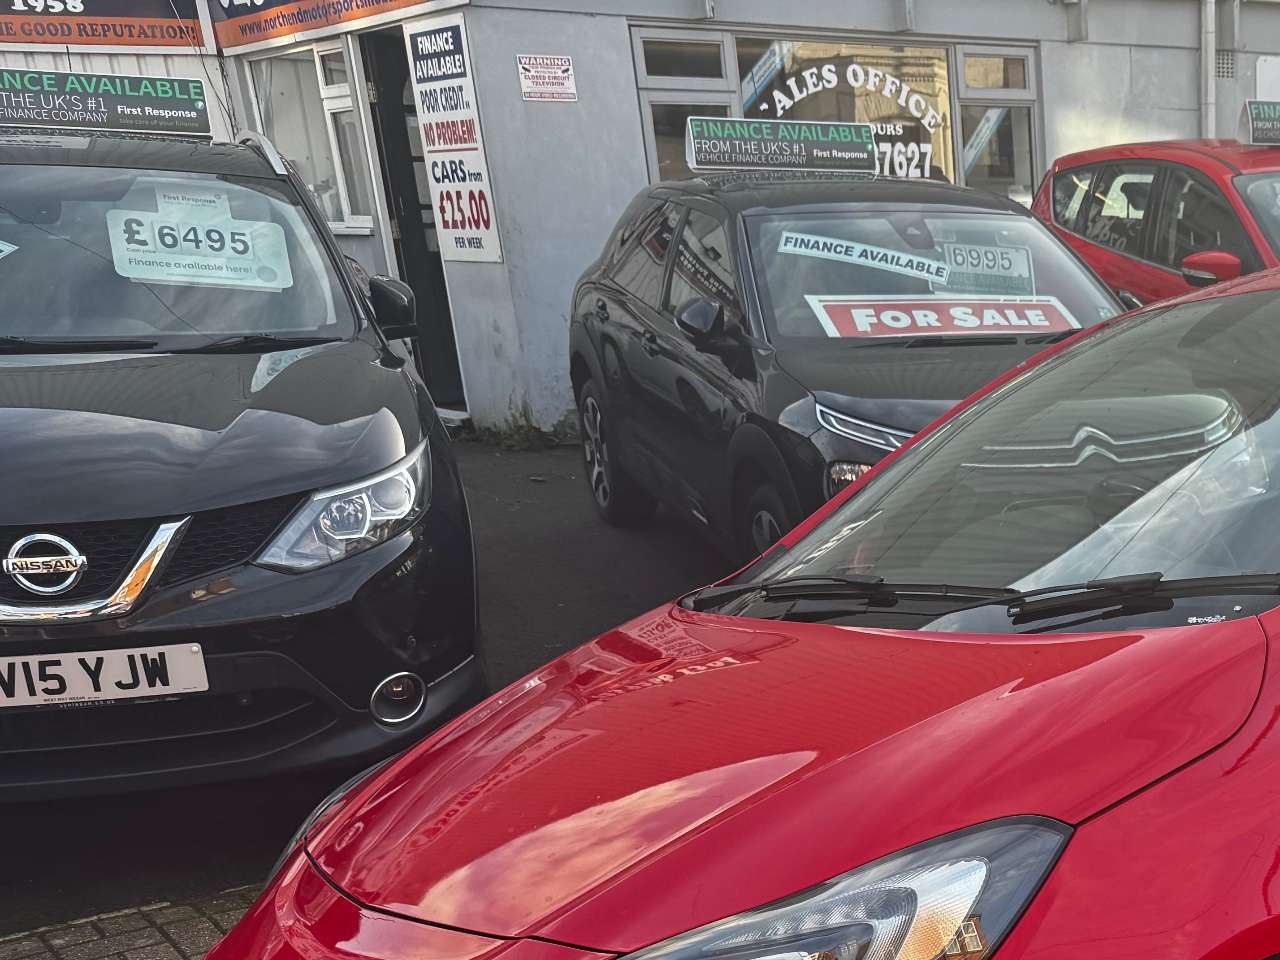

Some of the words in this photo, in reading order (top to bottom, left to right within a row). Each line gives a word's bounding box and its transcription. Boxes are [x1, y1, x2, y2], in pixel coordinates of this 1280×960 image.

[21, 22, 73, 37] GOOD
[76, 22, 197, 40] REPUTATION!
[417, 31, 454, 55] FINANCE
[416, 54, 464, 80] AVAILABLE!
[520, 56, 570, 66] WARNING
[0, 71, 58, 91] NCE
[65, 75, 204, 101] AVAILABLE
[40, 93, 82, 111] UK'S
[87, 96, 109, 112] #1
[419, 88, 441, 114] POOR
[760, 64, 838, 117] ALES
[846, 63, 943, 134] OFFICE
[51, 110, 109, 123] COMPANY
[117, 105, 143, 116] First
[145, 106, 198, 120] Response
[423, 121, 435, 147] NO
[436, 118, 478, 147] PROBLEM!
[692, 121, 775, 139] FINANCE
[778, 124, 872, 143] AVAILABLE
[695, 139, 731, 153] FROM
[733, 140, 760, 154] THE
[761, 141, 791, 155] UK'S
[793, 143, 806, 156] #1
[696, 153, 730, 163] VEHICLE
[732, 153, 767, 164] FINANCE
[768, 154, 807, 165] COMPANY
[813, 148, 831, 158] First
[832, 149, 868, 160] Response
[432, 159, 467, 184] CARS
[467, 170, 483, 183] from
[875, 142, 933, 178] 7627
[439, 189, 491, 231] £25.00
[454, 236, 467, 249] PER
[466, 236, 484, 250] WEEK
[128, 257, 171, 269] Finance
[173, 259, 224, 273] available
[783, 235, 854, 257] FINANCE
[857, 248, 946, 279] AVAILABLE
[952, 247, 1013, 271] 6995
[851, 308, 942, 332] FOR
[949, 306, 1050, 328] SALE
[12, 560, 78, 571] NISSAN
[78, 651, 170, 693] YJW
